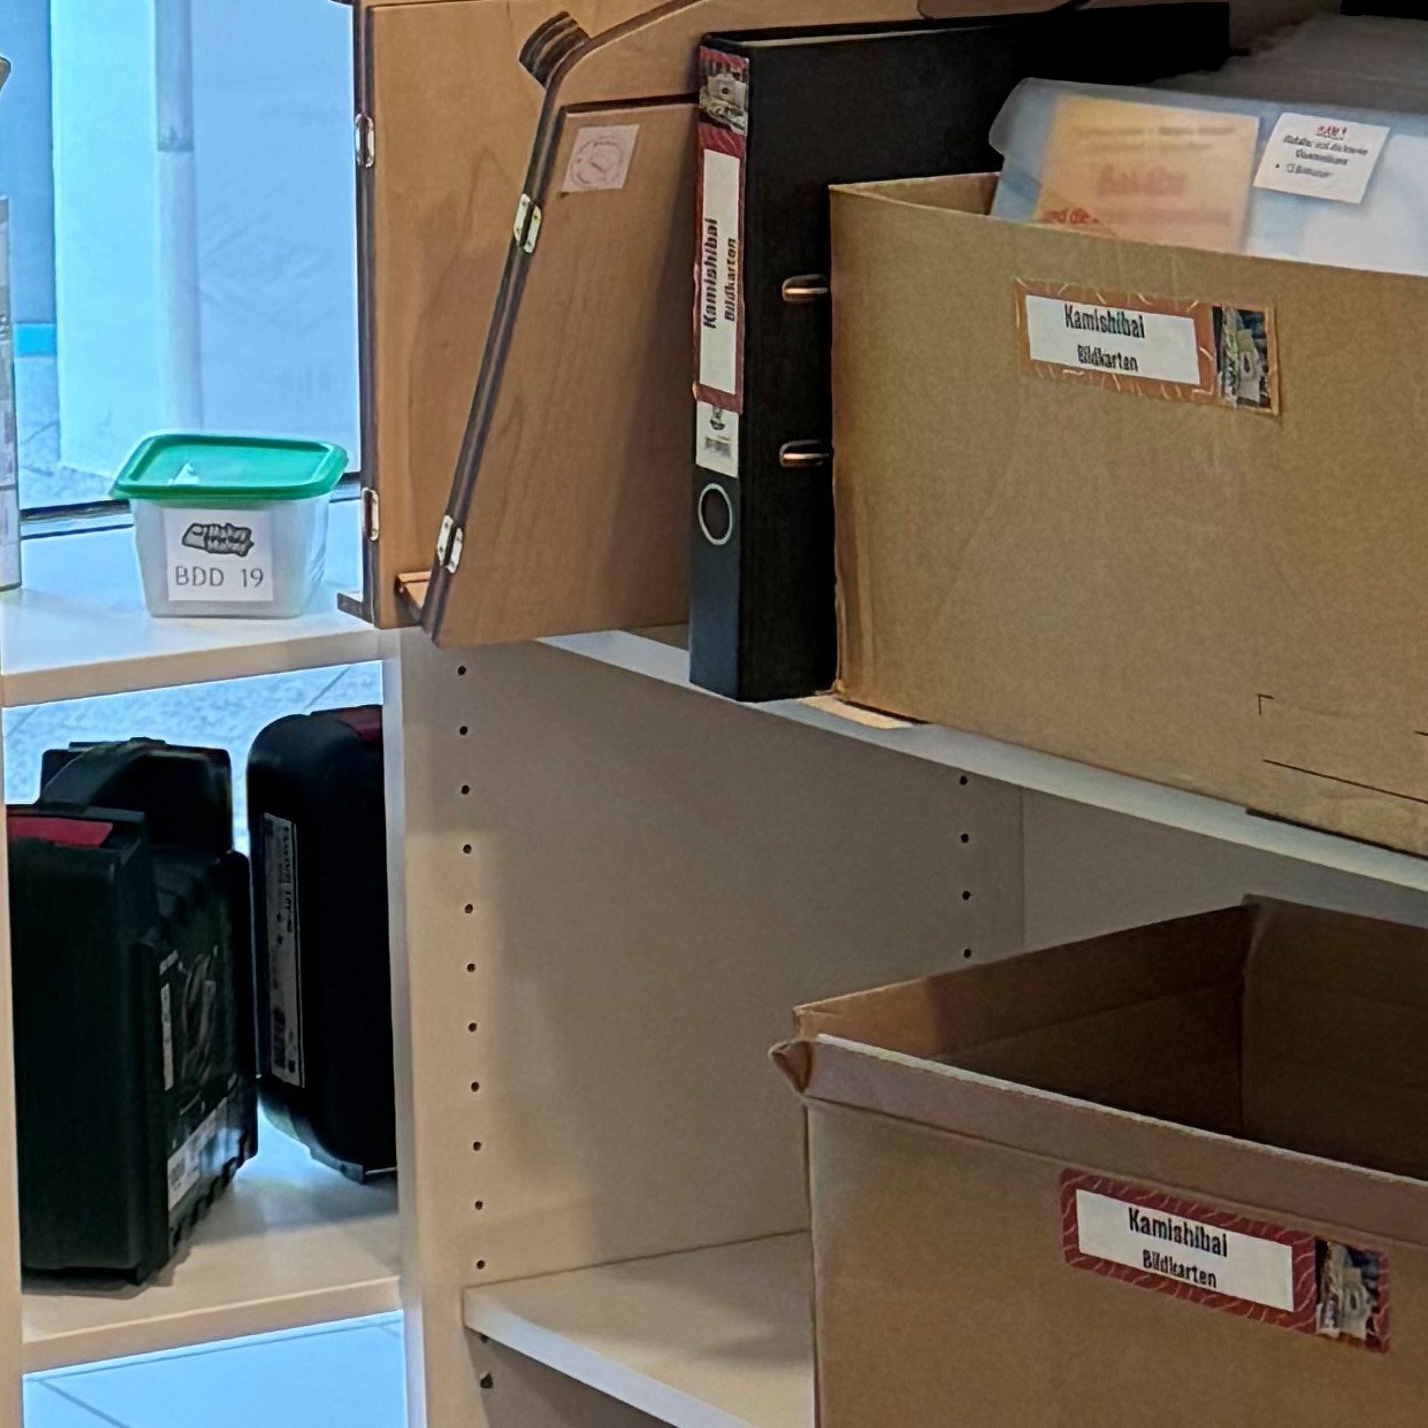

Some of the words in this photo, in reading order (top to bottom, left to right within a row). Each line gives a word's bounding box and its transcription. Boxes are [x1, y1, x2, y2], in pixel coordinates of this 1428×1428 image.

[703, 217, 718, 329] Kamishibai
[1064, 303, 1146, 340] Kamishibai
[1077, 345, 1139, 373] Bildkarten
[175, 565, 224, 587] BDD
[241, 567, 265, 589] 19
[1127, 1204, 1229, 1260] Kamishibai
[1142, 1248, 1219, 1290] Bildkarten
